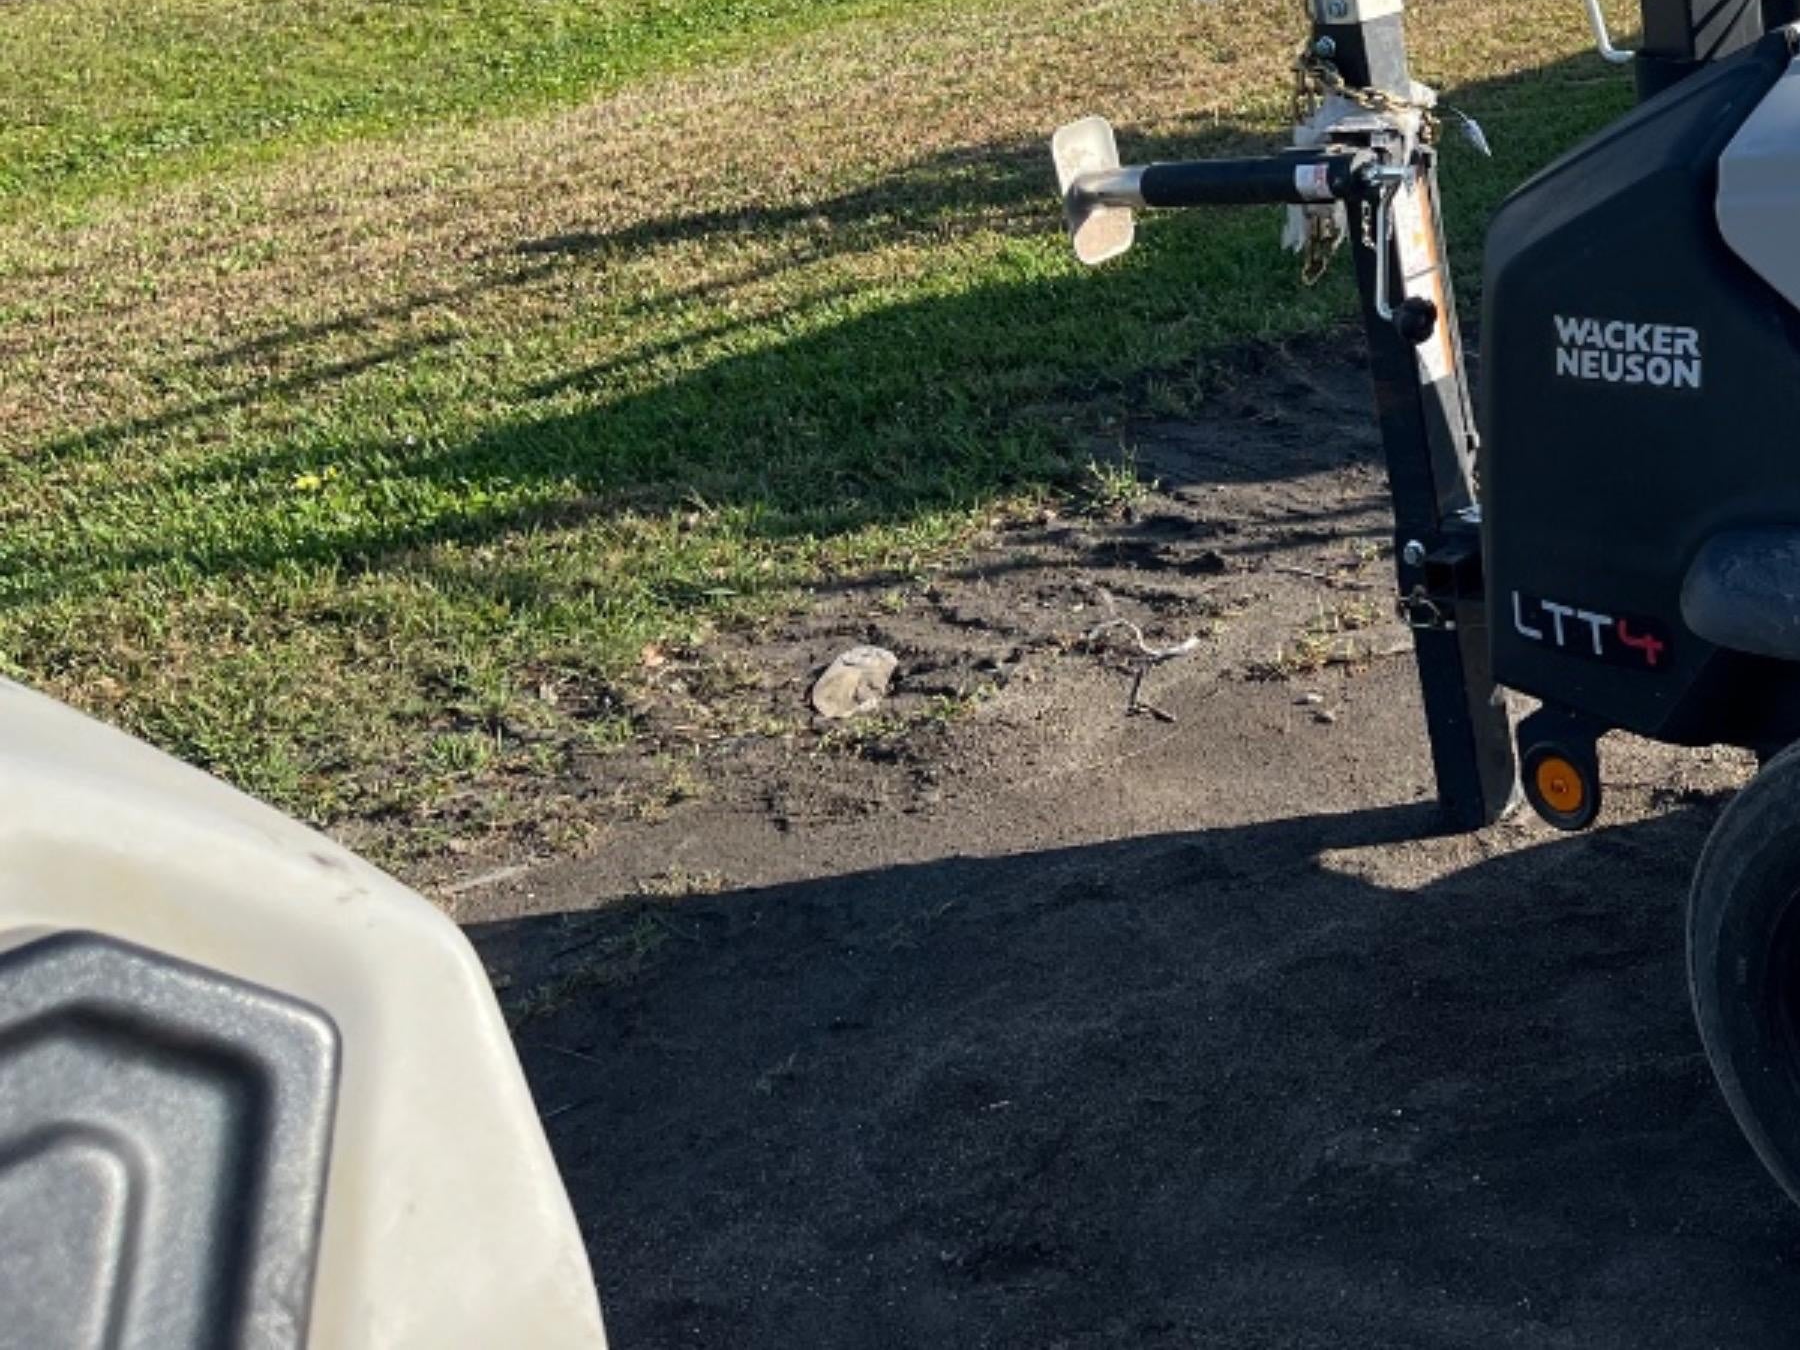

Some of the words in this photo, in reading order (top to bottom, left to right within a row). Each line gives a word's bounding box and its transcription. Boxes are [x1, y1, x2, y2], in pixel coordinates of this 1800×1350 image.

[1553, 313, 1701, 357] WACKER
[1556, 347, 1701, 389] NEUSON
[1511, 590, 1664, 665] LTT4
